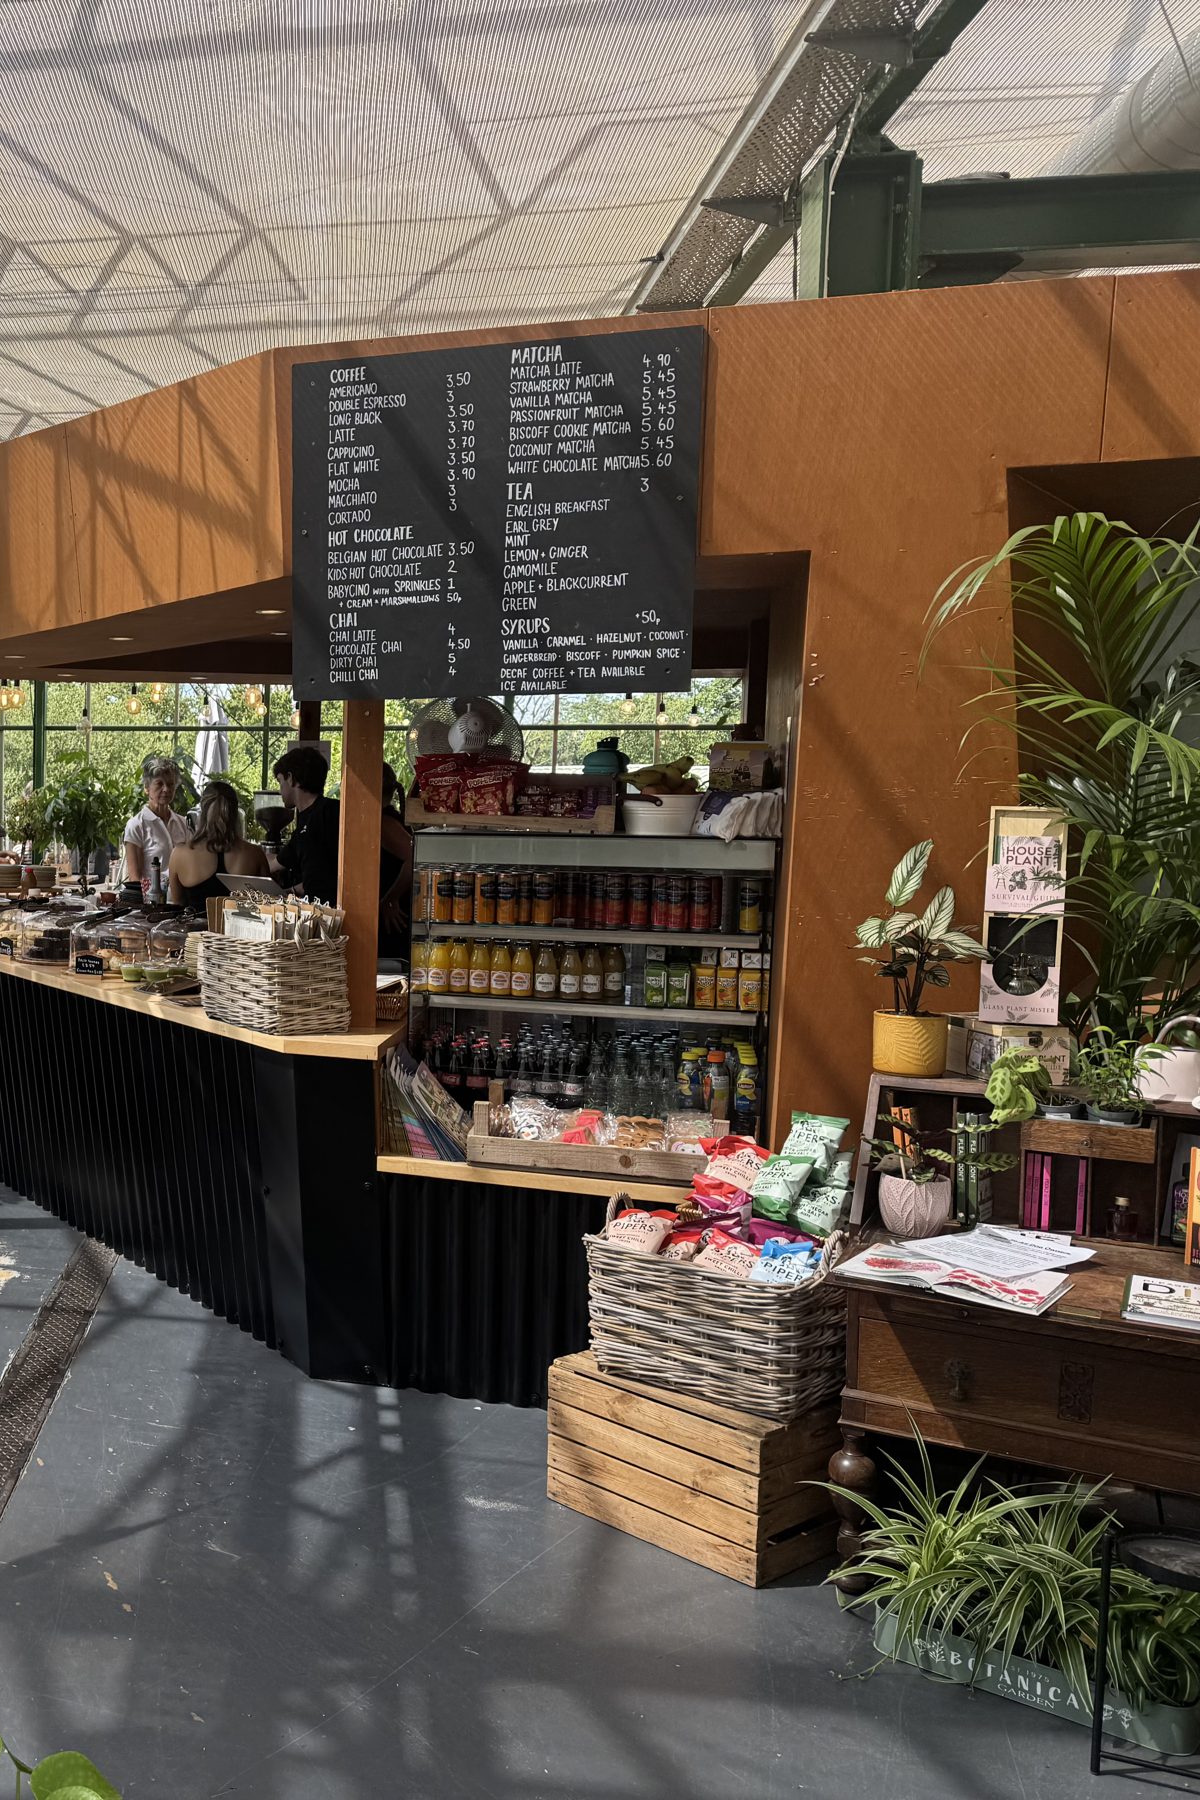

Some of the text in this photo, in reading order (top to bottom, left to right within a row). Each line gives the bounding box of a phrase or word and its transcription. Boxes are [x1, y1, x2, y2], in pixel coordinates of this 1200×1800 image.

[512, 345, 562, 364] MATCHA
[330, 367, 366, 383] COFFEE
[510, 354, 670, 379] MATCHA LATTE 4.90
[329, 372, 470, 398] AMERICANO 3.50
[510, 368, 675, 394] STRAWBERRY MATCHA 5.45
[329, 391, 454, 412] DOUBLE ESPRESSO 3
[510, 385, 676, 408] VANILLA MATCHA 5.45
[329, 404, 474, 426] LONG BLACK 3.50
[510, 400, 676, 423] PASSIONFRUIT MATCHA 5.45
[329, 420, 474, 444] LATTE 3.70
[510, 417, 674, 441] BISCOFF COOKIE MATCHA 5.60
[328, 436, 474, 460] CAPPUCINO 3.70
[509, 435, 674, 457] COCONUT MATCHA 5.45
[328, 451, 475, 477] FLAT WHITE 3.50
[508, 453, 672, 474] WHITE CHOCOLATE MATCHA 5.60
[329, 468, 475, 493] MOCHA 3.90
[506, 478, 649, 500] TEA 3
[328, 484, 456, 508] MACCHIATO 3
[328, 499, 456, 525] CORTADO 3
[506, 499, 610, 517] ENGLISH BREAKFAST
[506, 518, 559, 534] EARL GREY
[328, 526, 414, 547] HOT CHOCOLATE
[505, 534, 530, 547] MINT
[328, 541, 474, 564] BELGIAN HOT CHOCOLATE 3.50
[505, 546, 588, 562] LEMON GINGER
[328, 560, 457, 580] KIDS HOT CHOCOLATE 2
[504, 562, 558, 579] CAMOMILE
[328, 584, 370, 599] BABYCINO
[394, 578, 440, 592] SPRINKLES
[448, 578, 455, 589] 1
[504, 573, 628, 595] APPLE BLACKCURRENT
[347, 598, 372, 608] CREAM
[381, 594, 440, 606] MARSHMALLOWS
[502, 597, 536, 612] GREEN
[330, 612, 357, 629] CHAI
[501, 617, 550, 635] SYRUPS
[330, 623, 455, 642] CHAI LATTE 4
[503, 630, 684, 650] VANILLA CARAMEL HAZELNUT COCONUT
[330, 638, 470, 656] CHOCOLATE CHAI 4.50
[566, 651, 600, 661] BISCOFF
[612, 649, 651, 660] PUMPKIN
[657, 648, 680, 658] SPICE
[330, 653, 456, 669] DIRTY CHAI 5
[330, 666, 456, 683] CHILLI CHAI 4
[500, 666, 645, 679] DECAF COFFEE TEA AVAILABLE
[501, 680, 567, 691] ICE AVAILABLE
[1006, 846, 1052, 856] HOUSE
[1006, 856, 1052, 866] PLANT
[613, 1222, 655, 1232] PIPERS
[998, 1684, 1055, 1709] GARDEN
